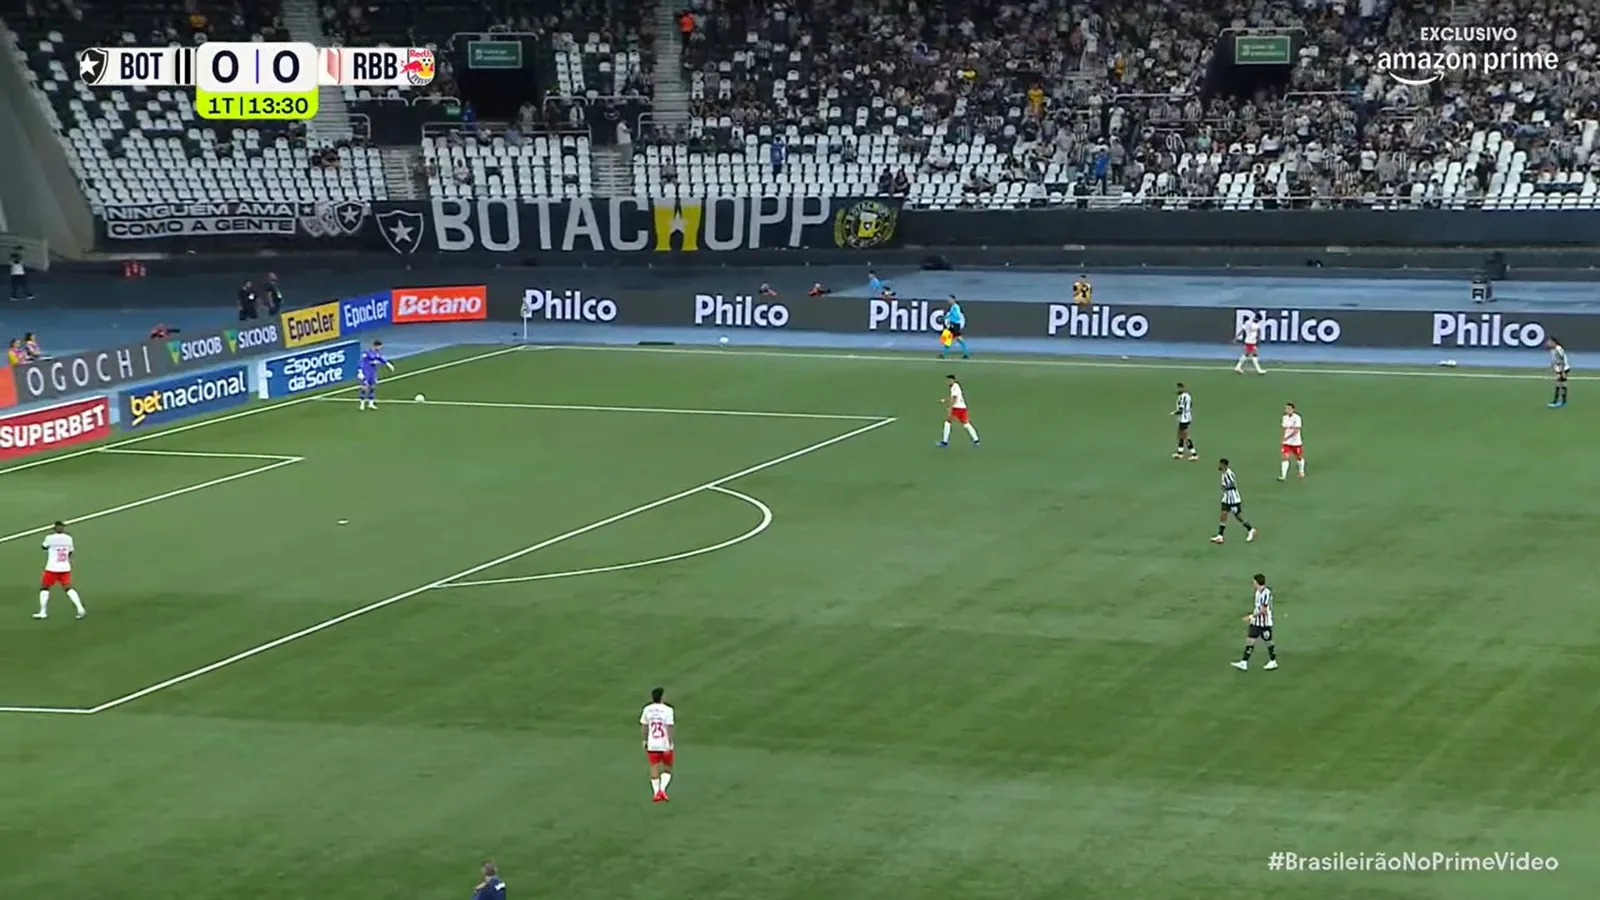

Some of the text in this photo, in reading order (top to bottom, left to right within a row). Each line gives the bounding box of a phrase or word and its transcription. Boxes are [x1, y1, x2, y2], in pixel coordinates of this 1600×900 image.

[107, 202, 294, 219] NINGUÉM AMA
[111, 218, 293, 236] COMO A GENTE
[344, 299, 389, 328] Epocler
[398, 295, 481, 316] Betano
[524, 288, 617, 321] Philco
[695, 294, 789, 327] Philco
[288, 312, 335, 342] Epocler
[1048, 304, 1149, 338] Philco
[1432, 312, 1545, 347] Philco
[181, 336, 223, 361] SICOOB
[238, 325, 278, 349] SICOOB
[27, 345, 151, 396] OGOCHI
[284, 350, 346, 375] Esportes
[130, 371, 246, 426] betnacional
[0, 404, 105, 448] SUPERBET
[651, 721, 665, 739] 23
